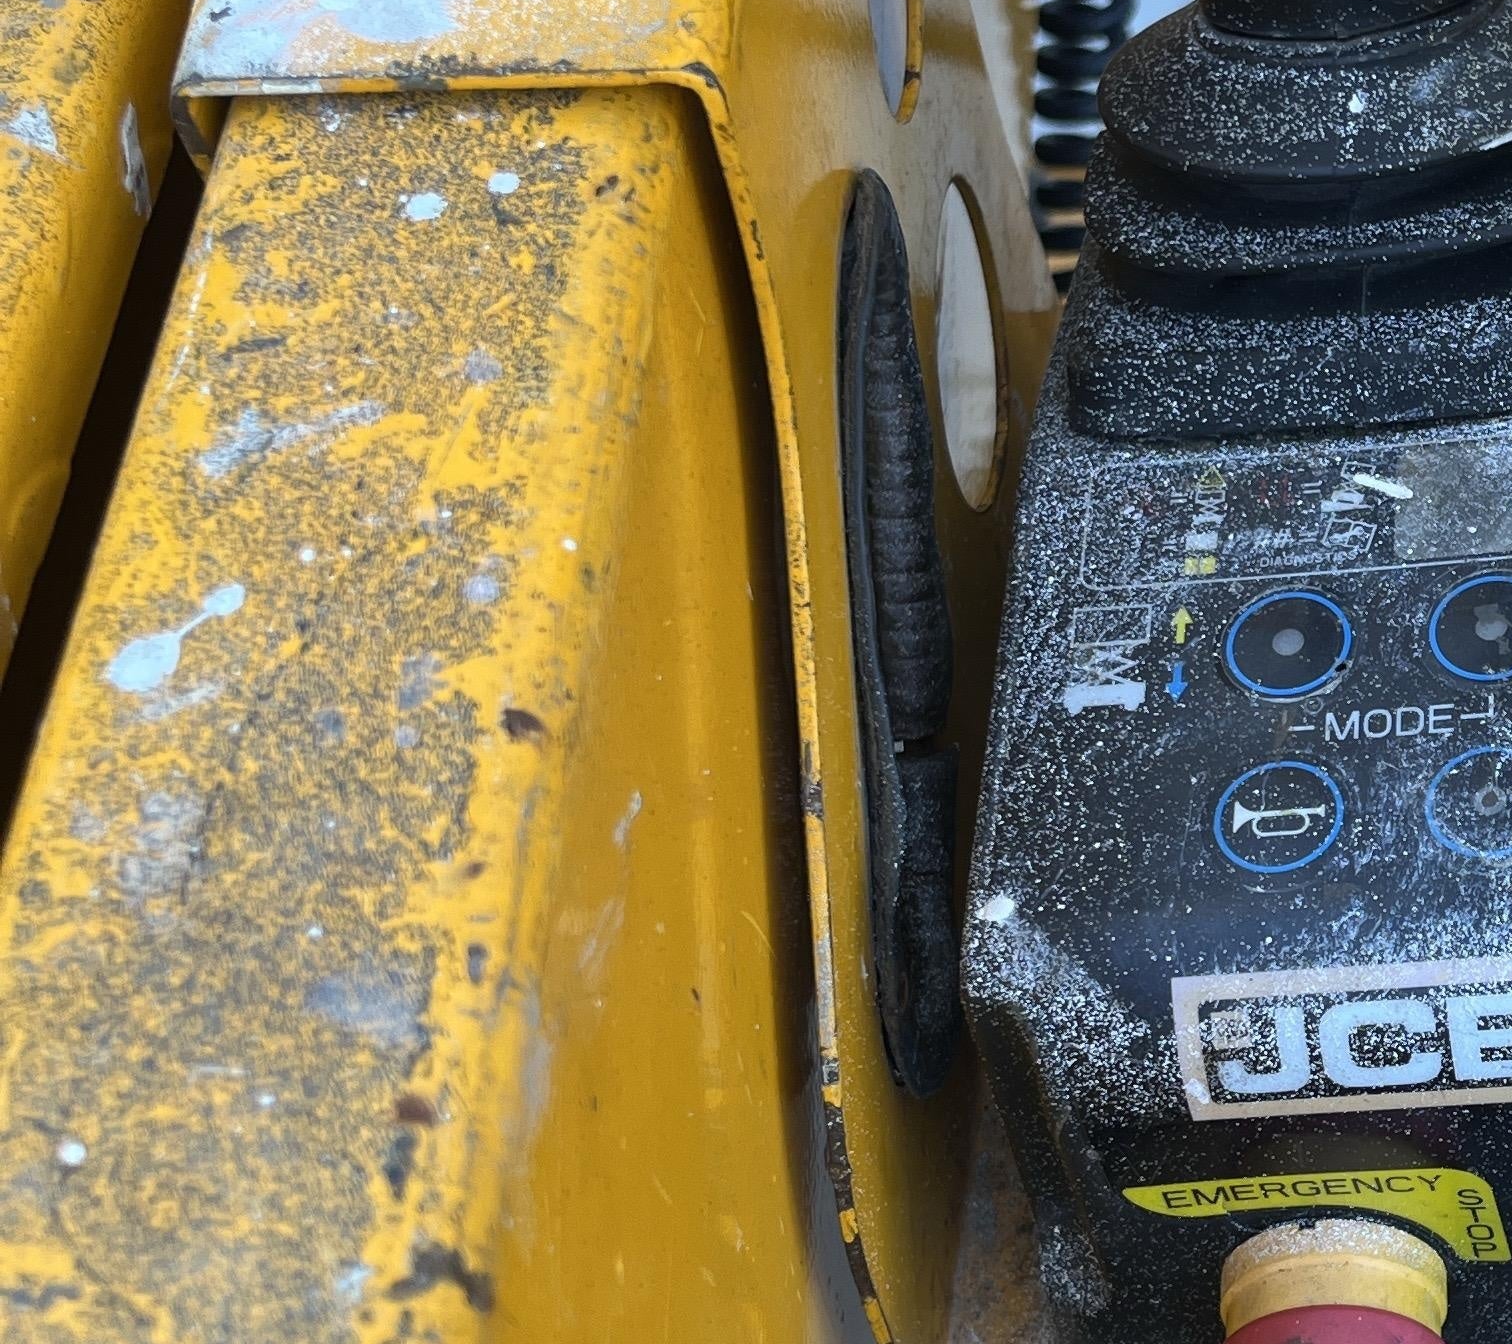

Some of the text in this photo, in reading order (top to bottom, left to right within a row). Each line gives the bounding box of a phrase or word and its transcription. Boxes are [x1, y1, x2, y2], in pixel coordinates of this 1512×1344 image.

[1259, 550, 1359, 569] DIAGNOSTICS
[1324, 703, 1456, 742] MODE
[1161, 1173, 1442, 1210] EMERGENCY
[1455, 1188, 1499, 1257] STOP
